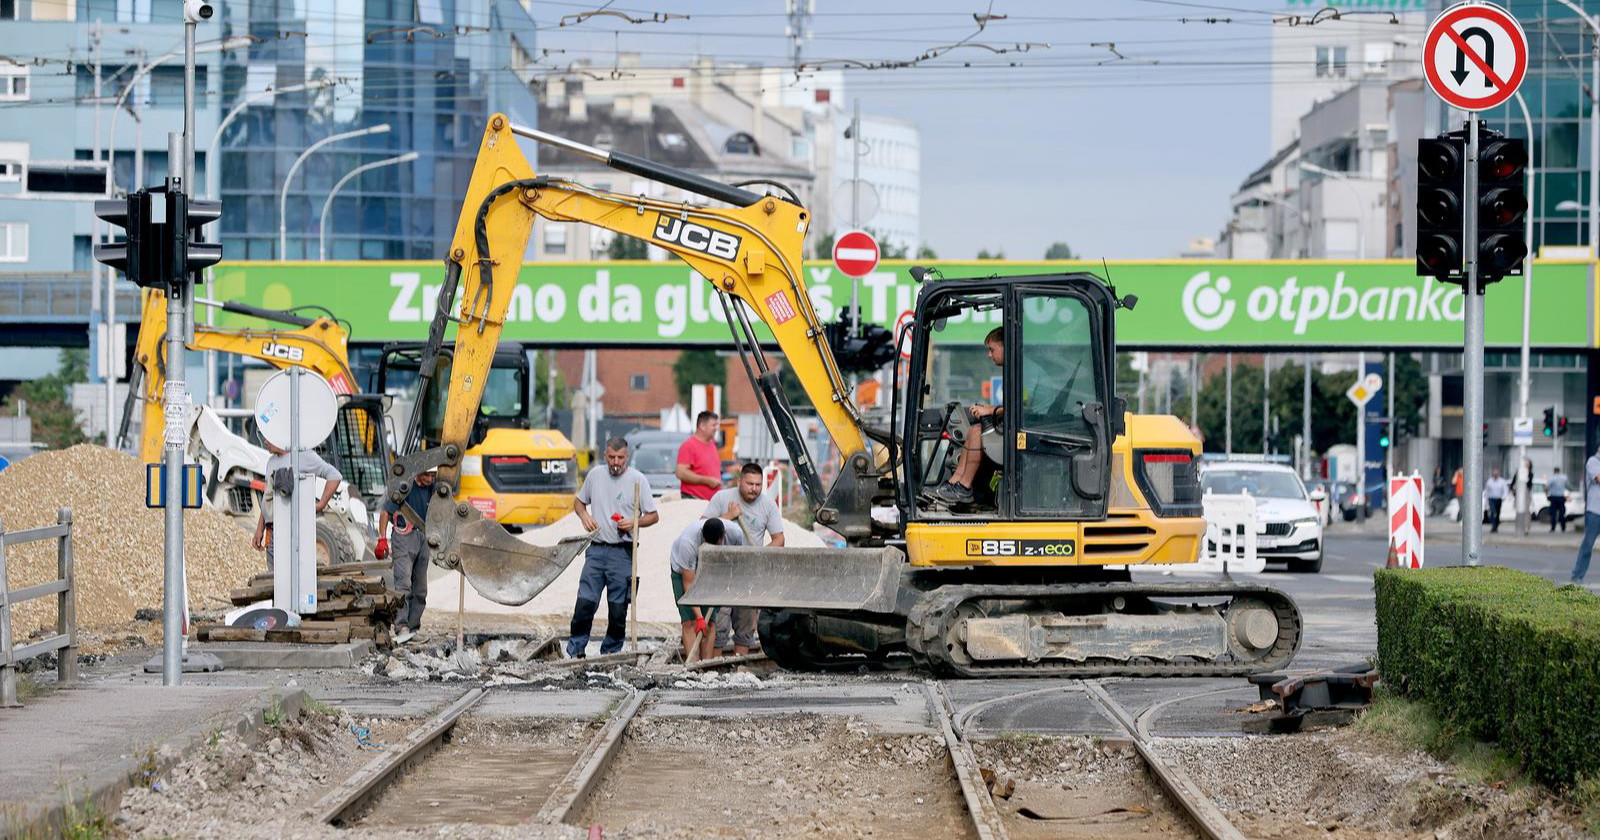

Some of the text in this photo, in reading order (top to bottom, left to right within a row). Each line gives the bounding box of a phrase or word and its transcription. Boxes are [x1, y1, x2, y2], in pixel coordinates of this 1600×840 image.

[656, 219, 738, 260] JCB
[578, 270, 643, 323] da
[262, 342, 303, 361] JCB
[541, 460, 568, 474] JCB
[982, 540, 1016, 555] 85
